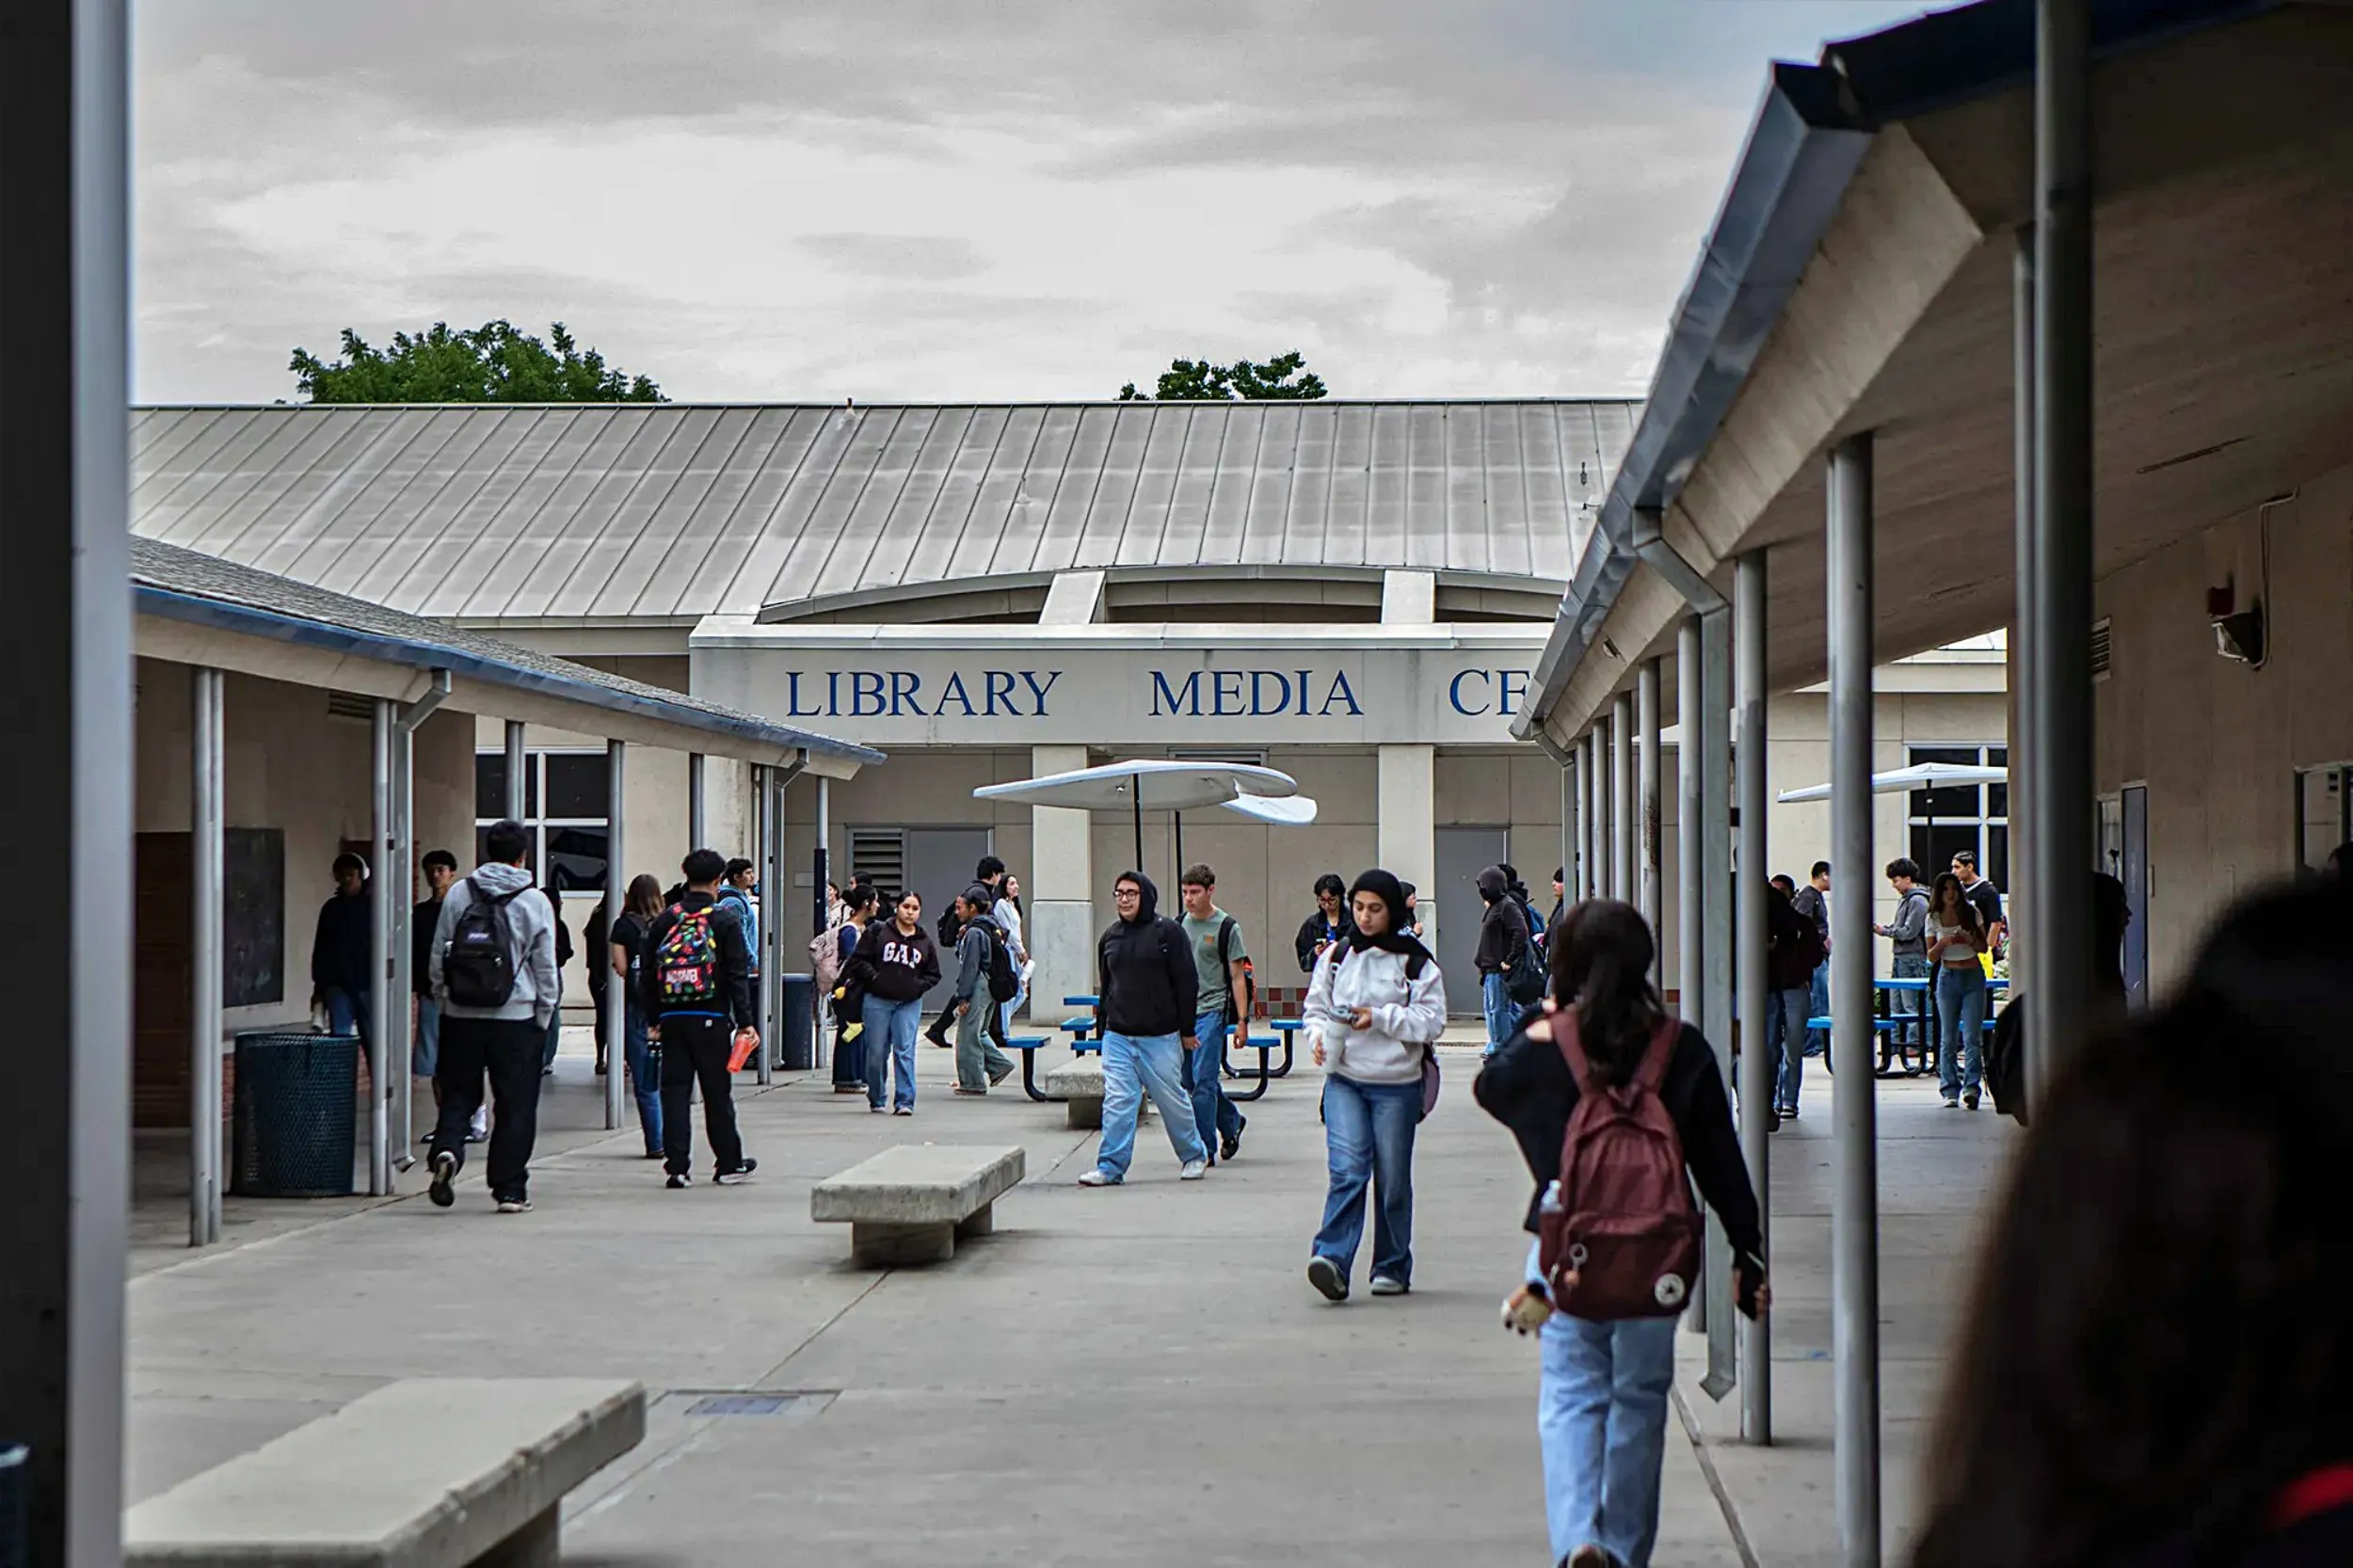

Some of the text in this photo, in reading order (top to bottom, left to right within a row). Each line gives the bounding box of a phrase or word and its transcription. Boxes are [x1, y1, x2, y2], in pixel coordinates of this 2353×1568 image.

[786, 671, 1063, 716] LIBRARY
[1148, 669, 1364, 715] MEDIA
[883, 941, 922, 968] GAP
